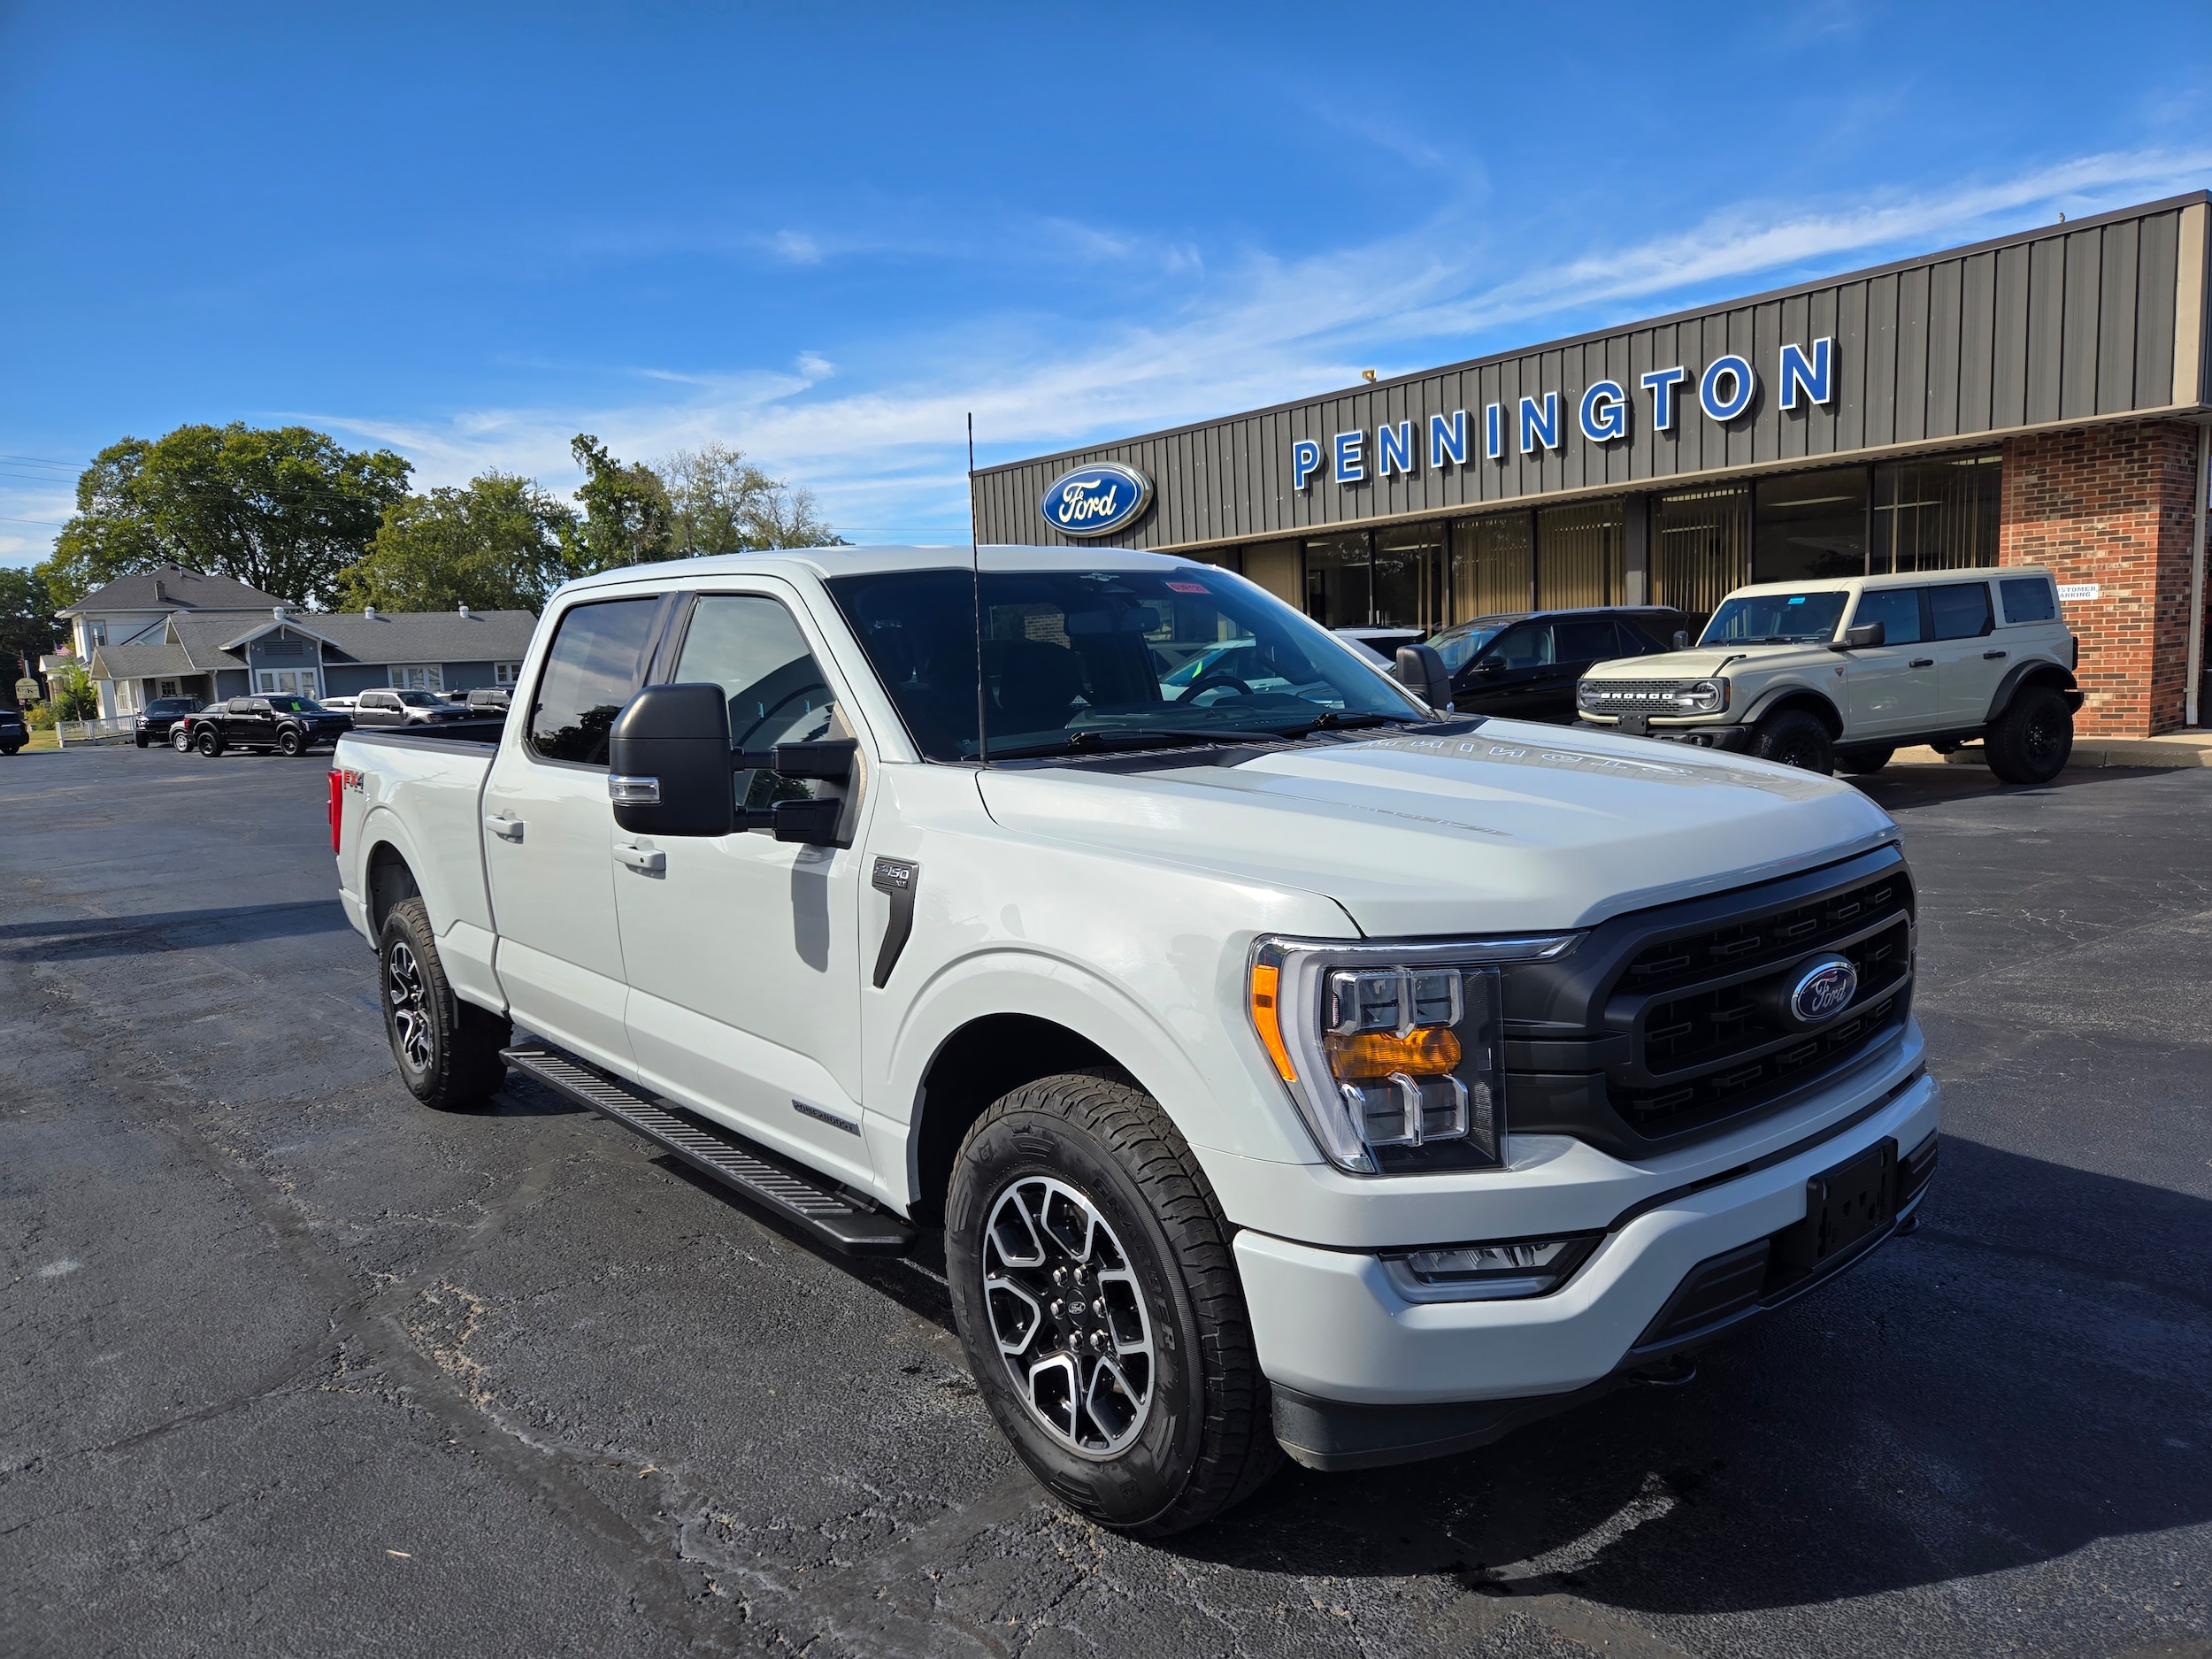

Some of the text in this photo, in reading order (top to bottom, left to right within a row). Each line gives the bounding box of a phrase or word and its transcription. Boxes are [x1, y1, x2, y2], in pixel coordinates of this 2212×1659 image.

[1293, 336, 1833, 491] PENNINGTON
[1058, 479, 1118, 523] Ford
[343, 770, 365, 790] FX4
[1811, 974, 1847, 1011] Ford
